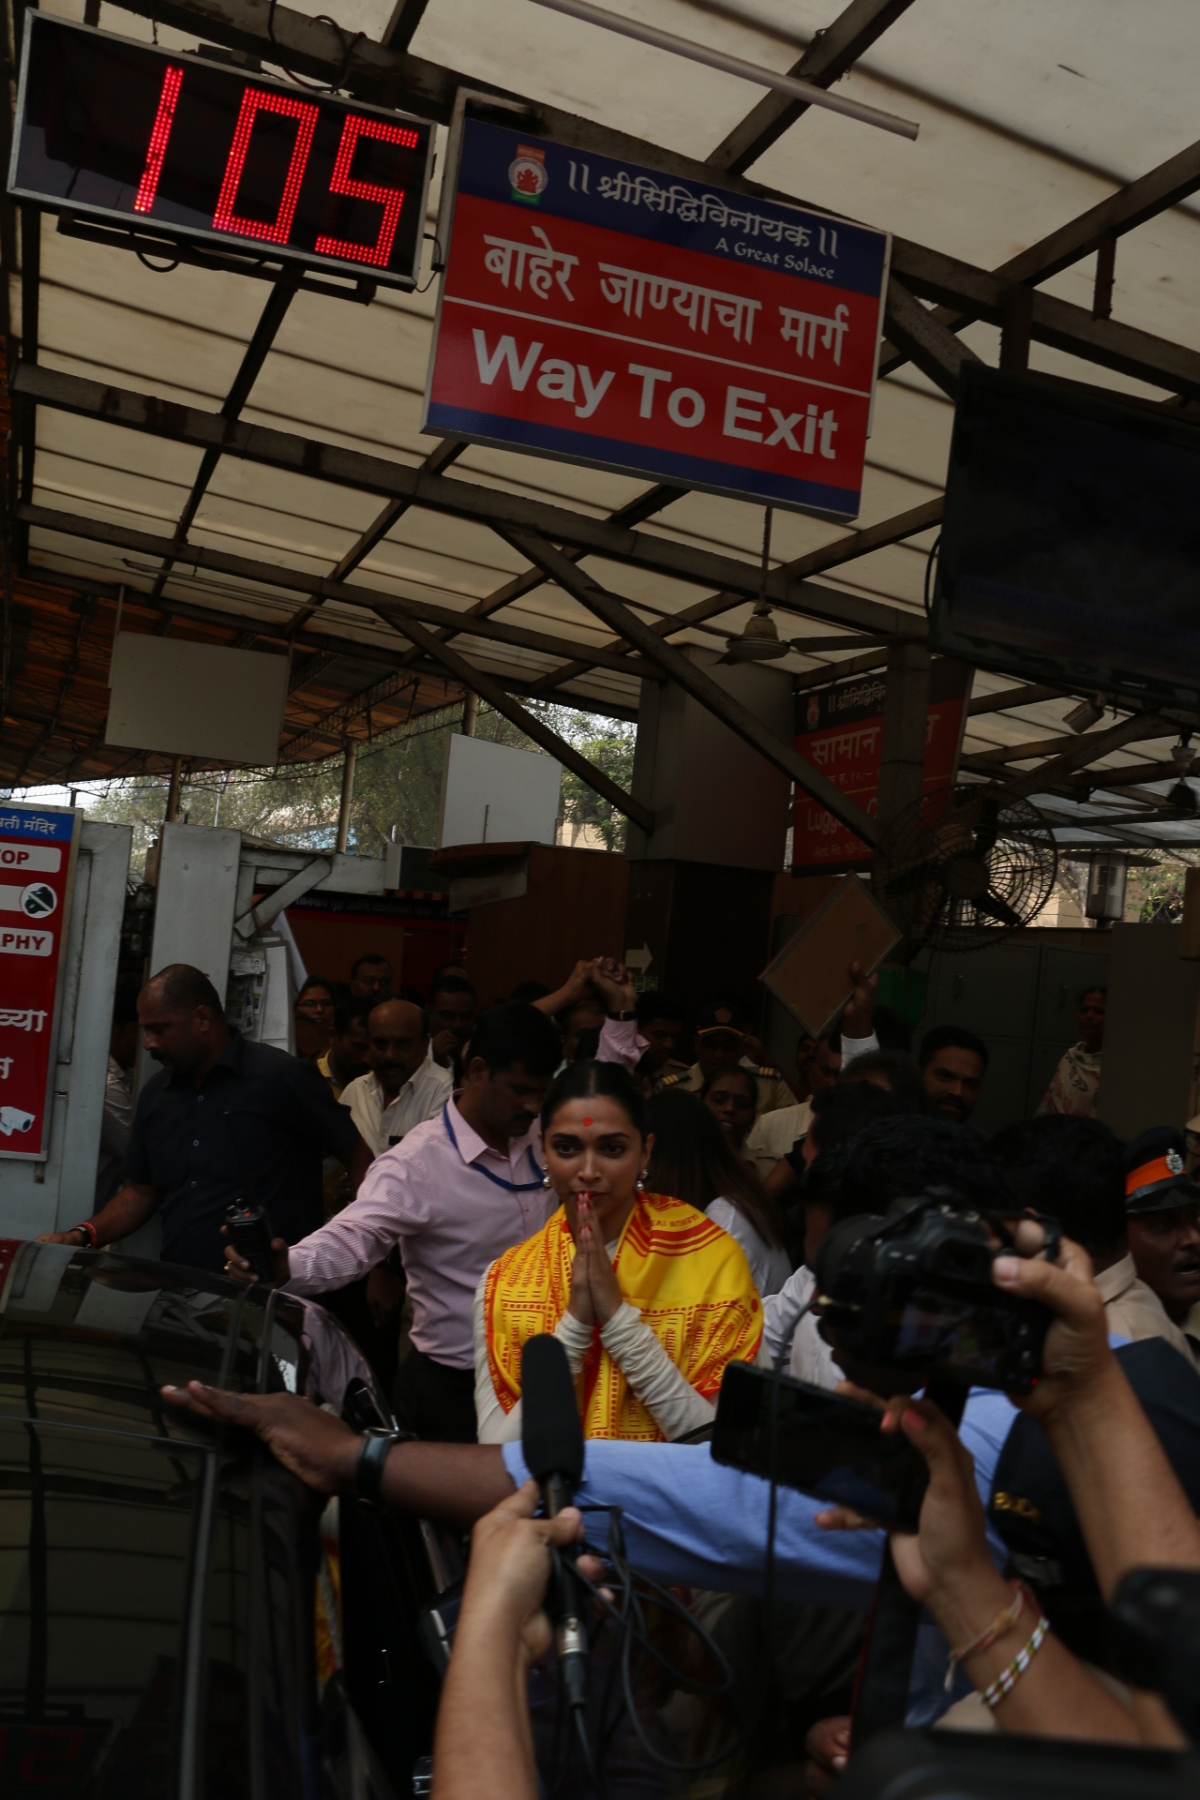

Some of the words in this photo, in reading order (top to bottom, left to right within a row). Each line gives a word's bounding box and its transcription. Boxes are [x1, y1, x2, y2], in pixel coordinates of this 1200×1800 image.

[134, 64, 420, 269] 105
[715, 237, 730, 253] A
[734, 243, 780, 266] Great
[784, 255, 835, 280] Solace
[482, 225, 578, 302] बाहेर
[598, 262, 763, 345] जाण्याचा
[779, 304, 850, 367] मार्ग
[472, 328, 616, 419] Way
[627, 363, 707, 429] To
[721, 385, 839, 460] Exit
[810, 726, 881, 766] सामान
[23, 816, 58, 835] मंदिर
[0, 848, 30, 865] OP
[0, 933, 46, 951] PHY
